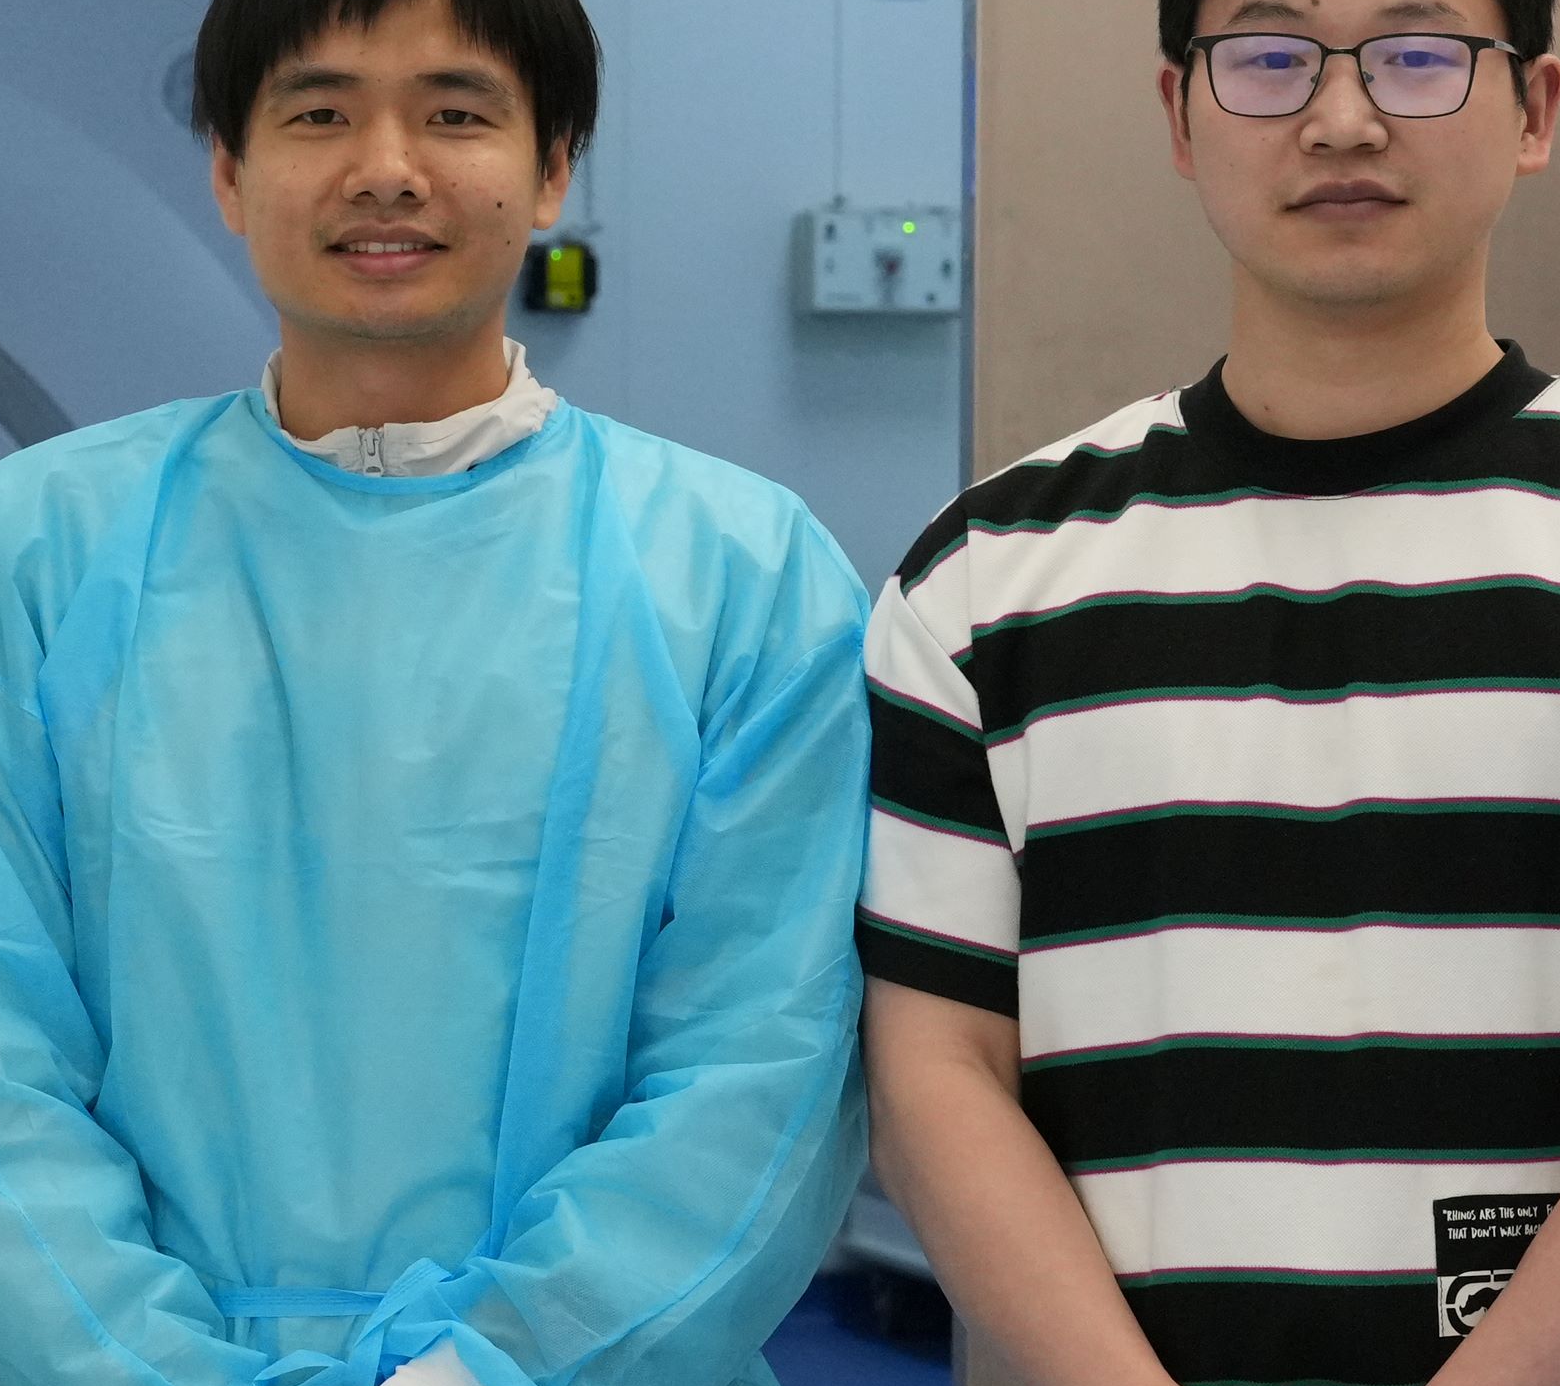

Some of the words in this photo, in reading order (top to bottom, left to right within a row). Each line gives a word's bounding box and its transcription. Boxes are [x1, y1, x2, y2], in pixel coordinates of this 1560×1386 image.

[1480, 1208, 1496, 1220] ARE
[1499, 1207, 1515, 1219] THE
[1518, 1206, 1538, 1217] ONLY
[1448, 1227, 1467, 1240] THAT
[1471, 1226, 1496, 1239] DON'T
[1500, 1225, 1521, 1238] WALK
